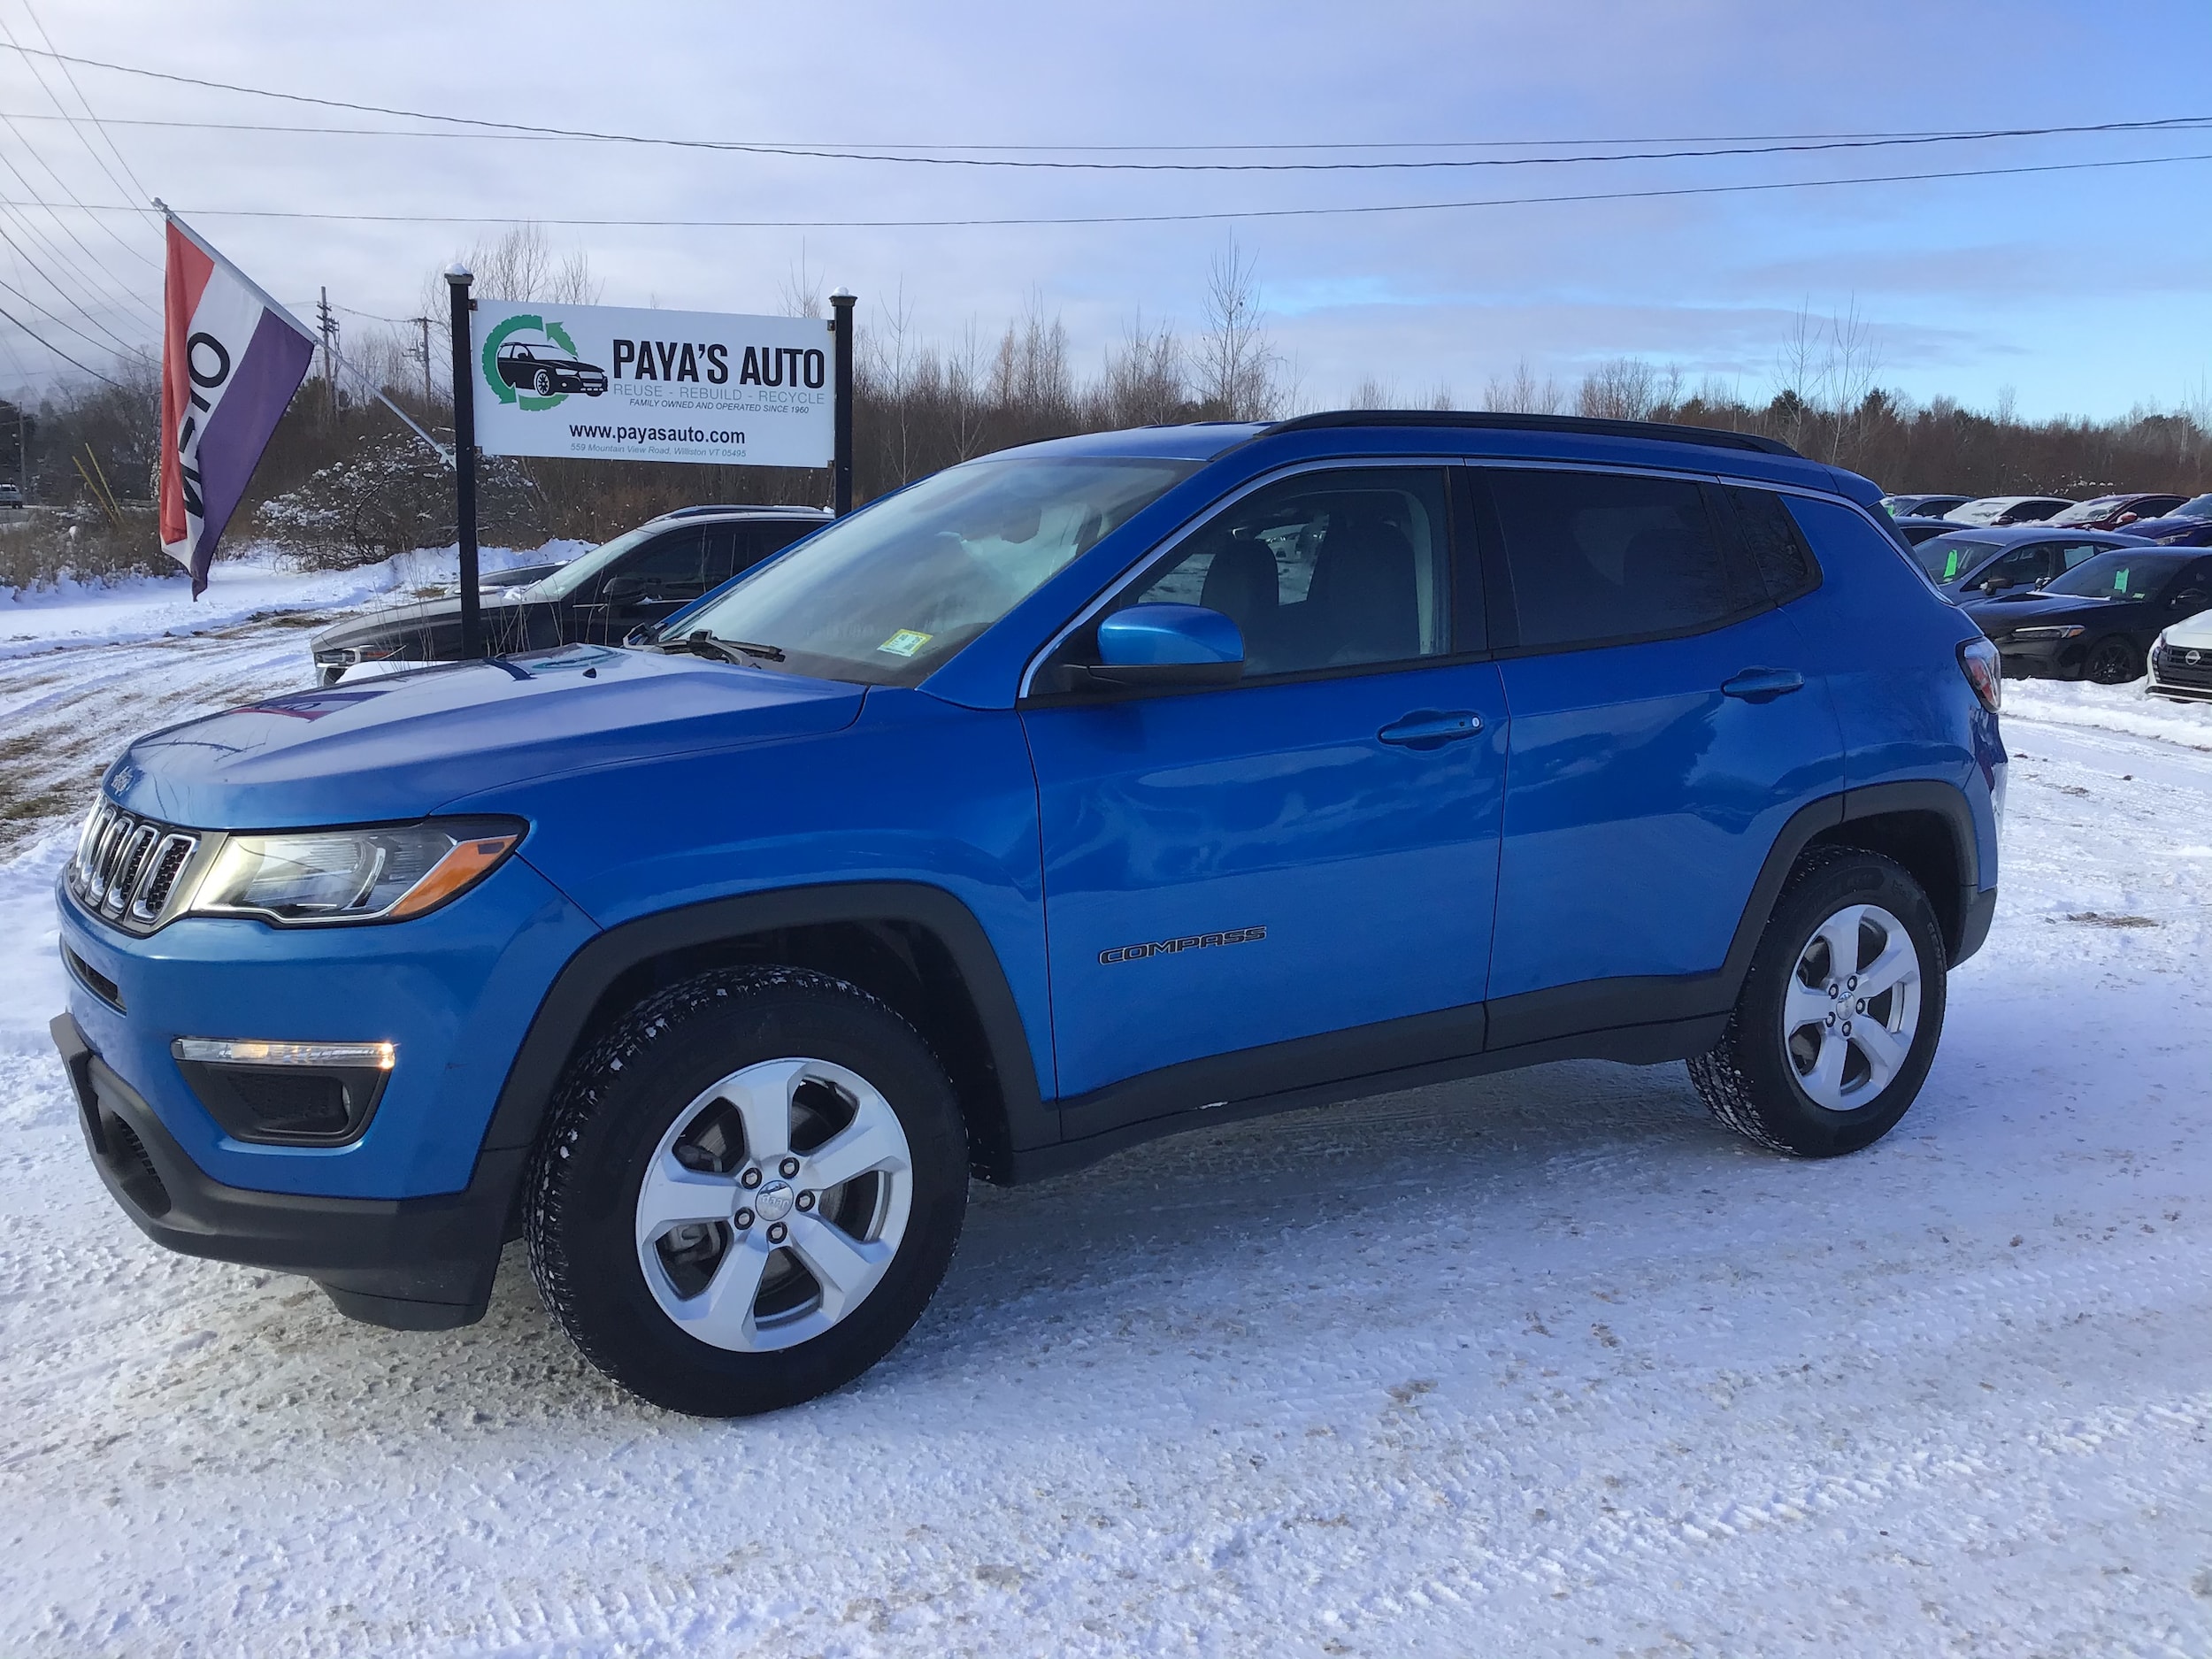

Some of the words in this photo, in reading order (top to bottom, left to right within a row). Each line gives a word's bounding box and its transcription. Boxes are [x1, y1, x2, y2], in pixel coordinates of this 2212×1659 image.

[612, 339, 728, 384] PAYA'S
[740, 346, 825, 389] AUTO
[613, 383, 663, 397] REUSE
[680, 387, 742, 401] REBUILD
[758, 390, 825, 404] RECYCLE
[629, 398, 660, 407] FAMILY
[661, 400, 694, 409] OWNED
[716, 403, 761, 411] OPERATED
[763, 404, 788, 413] SINCE
[569, 425, 745, 444] www.payasauto.com
[588, 444, 625, 453] Mountain
[648, 446, 672, 456] Road,
[674, 447, 707, 456] Williston
[721, 449, 747, 457] 05495
[1098, 926, 1267, 965] COMPASS
